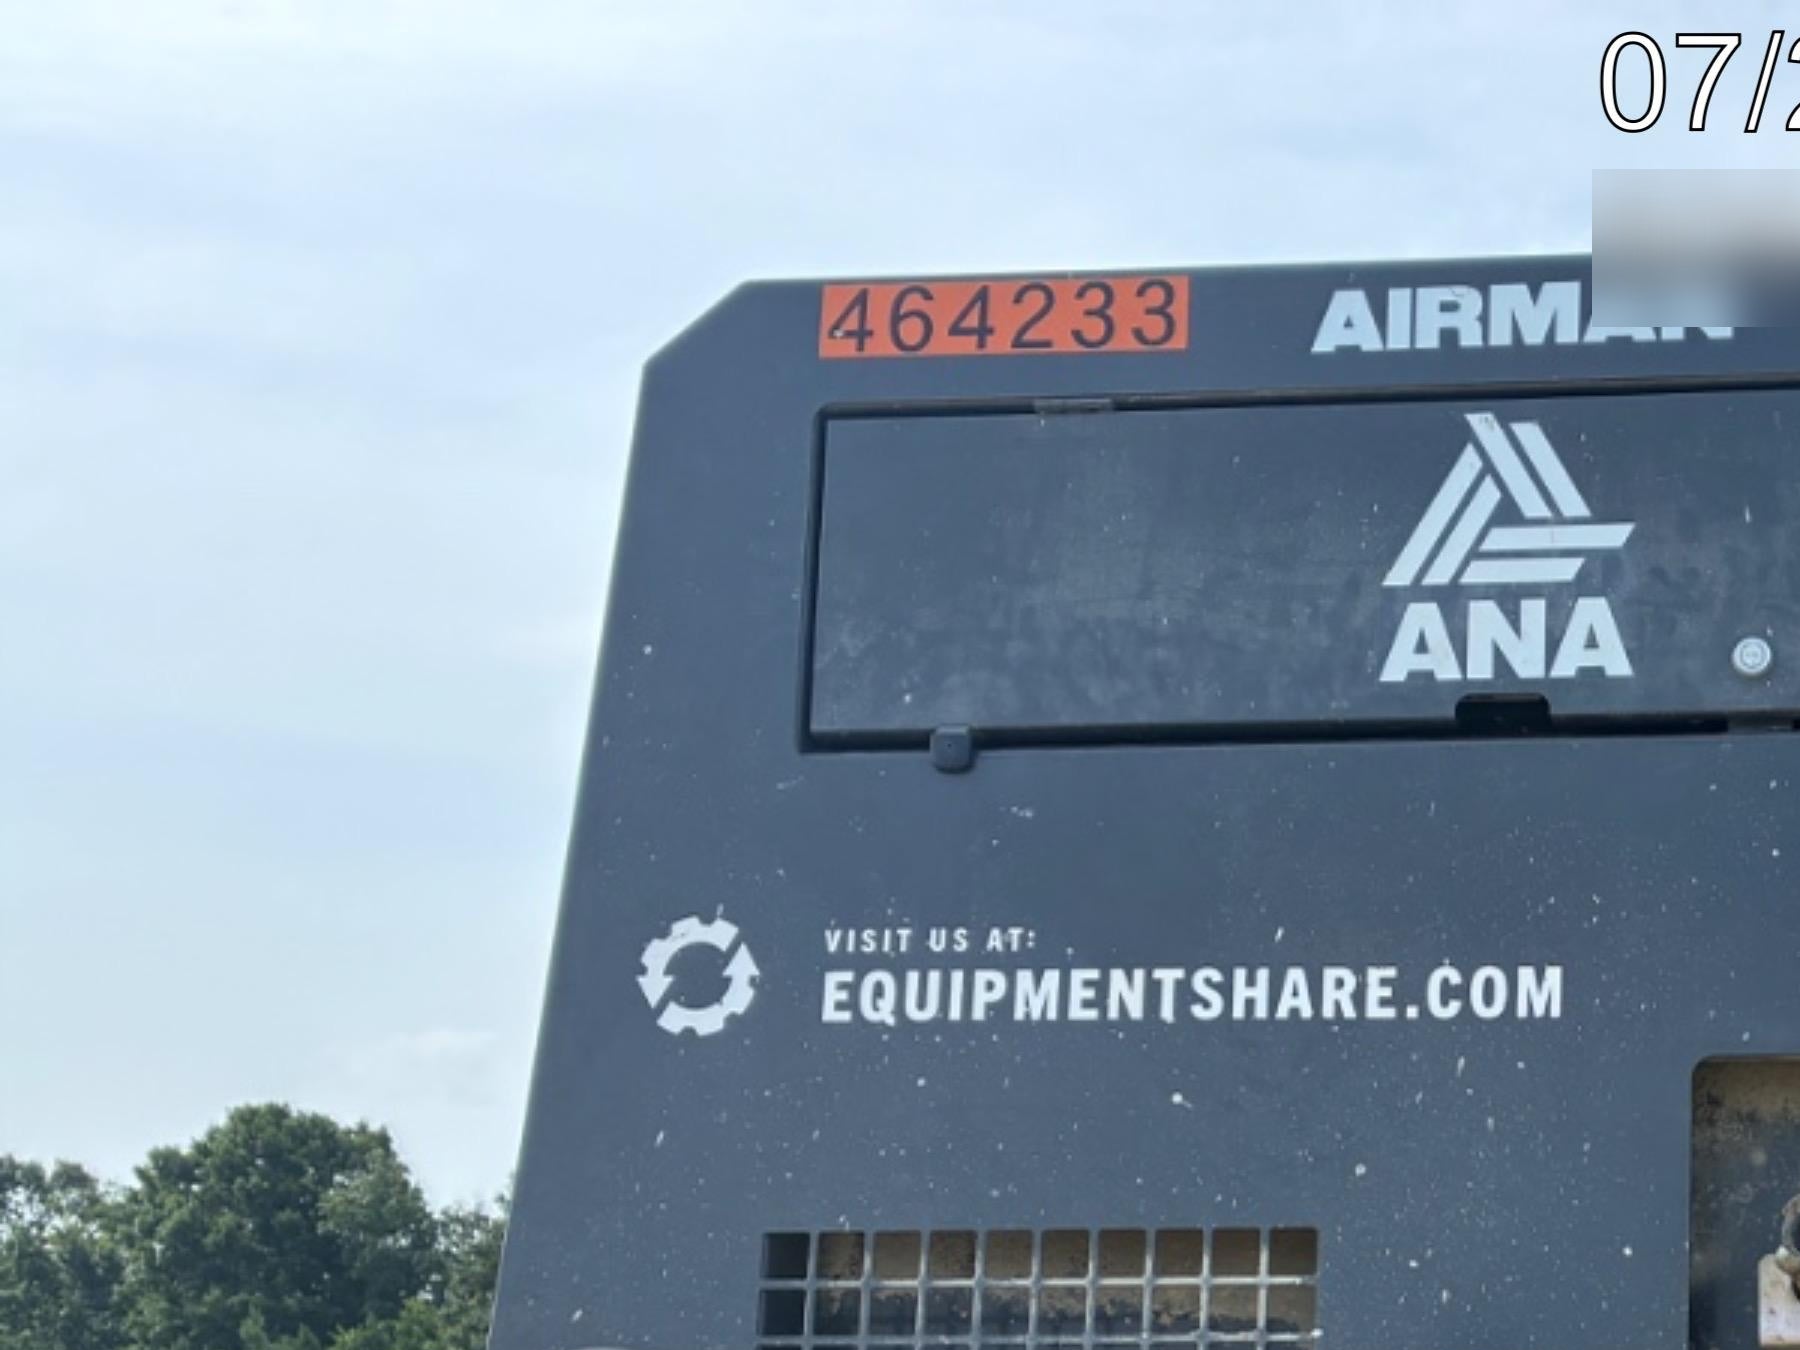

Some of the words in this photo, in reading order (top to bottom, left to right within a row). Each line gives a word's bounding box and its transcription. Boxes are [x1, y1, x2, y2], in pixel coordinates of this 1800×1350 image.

[828, 279, 1178, 353] 464233
[1379, 596, 1634, 682] ANA
[824, 928, 913, 953] VISIT
[928, 927, 969, 953] US
[986, 927, 1036, 952] AT:
[821, 964, 1562, 1027] EQUIPMENTSHARE.COM
